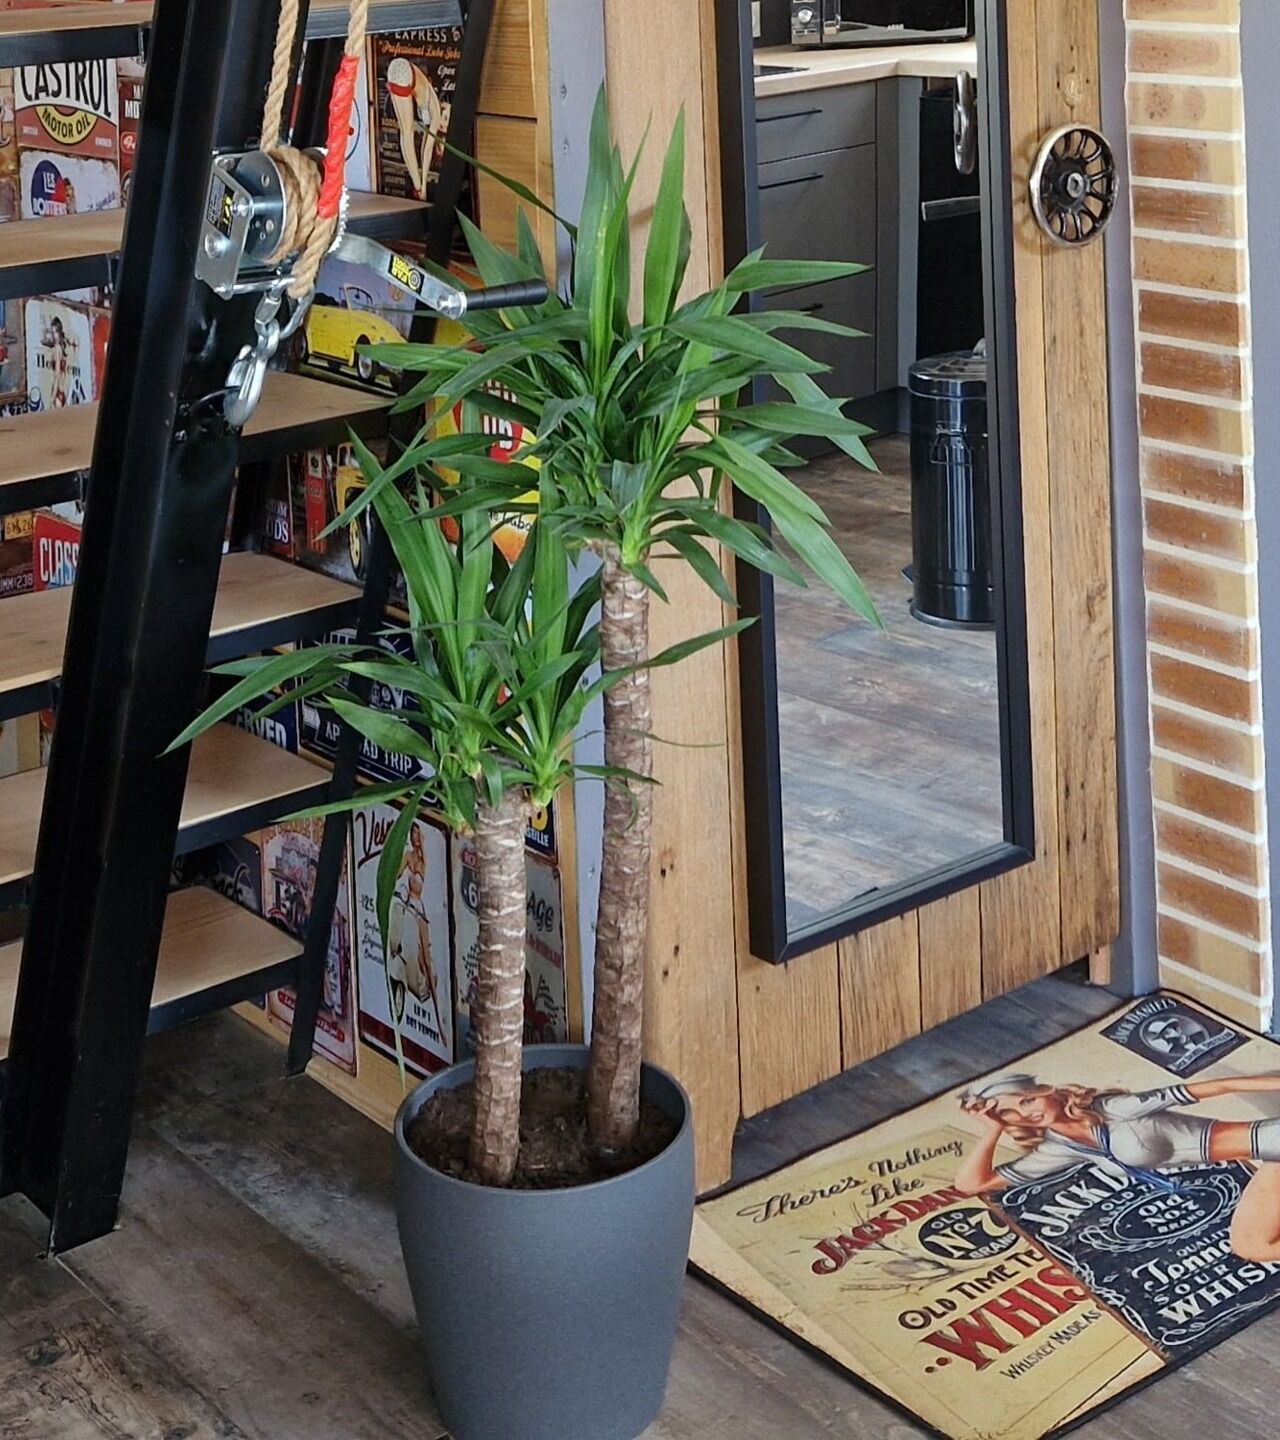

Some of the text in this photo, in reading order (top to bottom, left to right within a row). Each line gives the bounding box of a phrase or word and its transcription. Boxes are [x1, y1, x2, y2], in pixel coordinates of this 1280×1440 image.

[394, 28, 448, 44] EXPRESS
[20, 57, 112, 119] CASTROL
[41, 107, 92, 138] MOTOR OIL
[42, 171, 57, 194] LES
[735, 1139, 964, 1225] There's Nothing
[859, 1177, 926, 1210] Like
[1020, 1177, 1103, 1238] JACK
[1100, 1191, 1135, 1212] OLD
[1137, 1193, 1185, 1218] Old
[930, 1211, 965, 1230] OLD
[1154, 1209, 1207, 1234] BRAND
[810, 1209, 908, 1277] JACK
[968, 1232, 1020, 1261] BRAND
[898, 1262, 1020, 1331] OLD TIME
[1153, 1263, 1228, 1306] SOUR
[999, 1308, 1103, 1382] WHISKEY MADE AS
